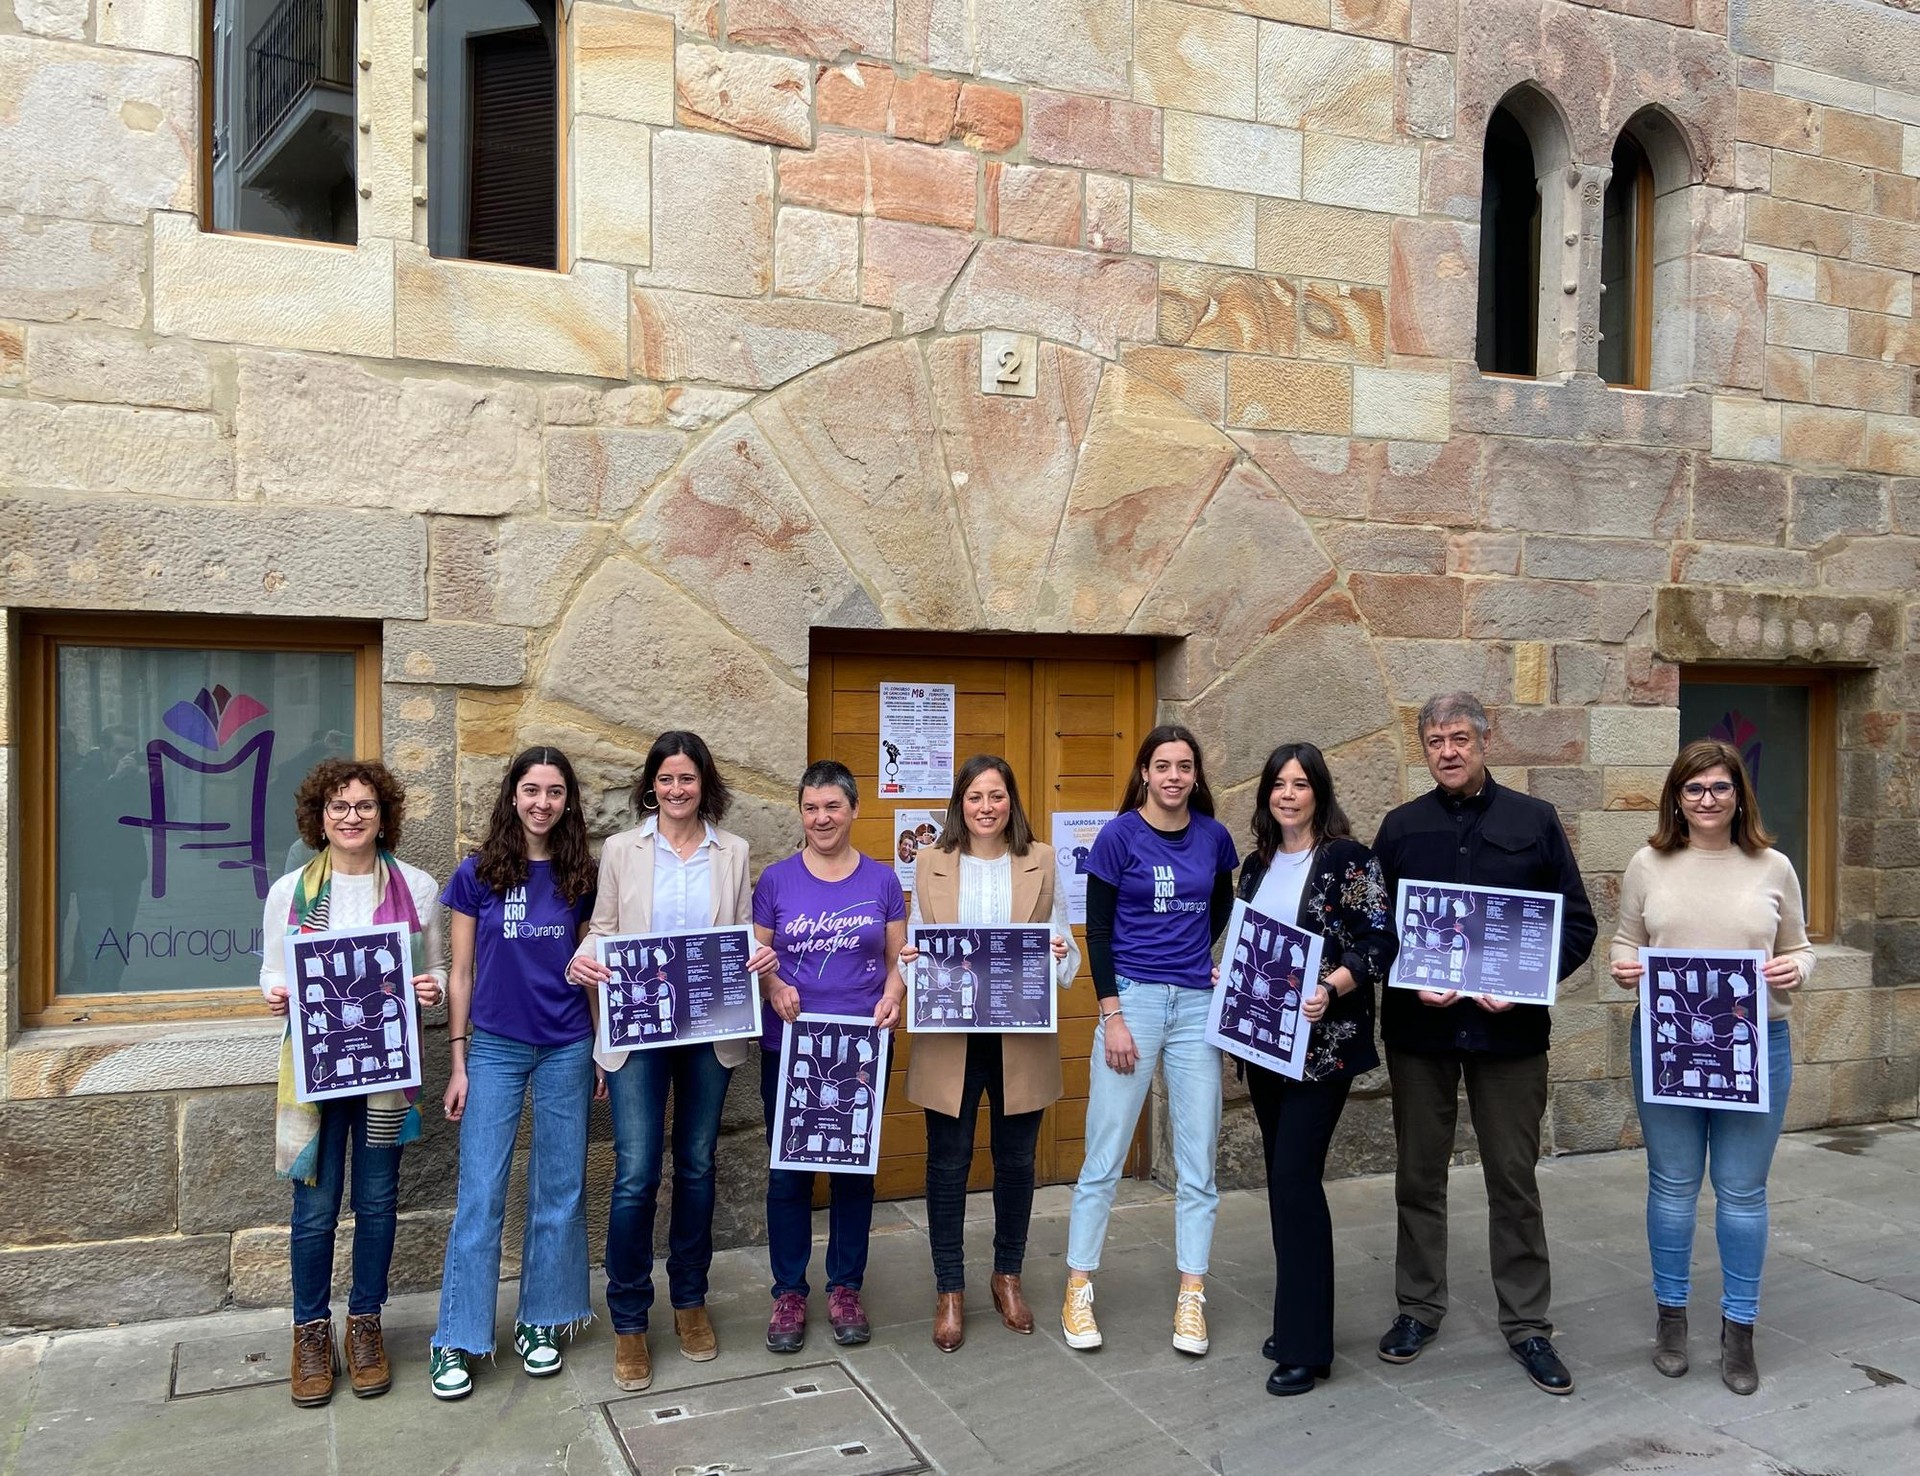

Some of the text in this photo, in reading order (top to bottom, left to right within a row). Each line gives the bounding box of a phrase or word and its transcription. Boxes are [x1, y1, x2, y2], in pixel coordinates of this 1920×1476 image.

[996, 345, 1021, 384] 2
[911, 688, 925, 698] M8
[1153, 865, 1175, 881] LILA
[1154, 881, 1175, 898] KRO
[504, 903, 526, 921] KRO
[1153, 898, 1167, 913] SA
[503, 921, 518, 939] SA
[785, 911, 874, 937] etorkizuna
